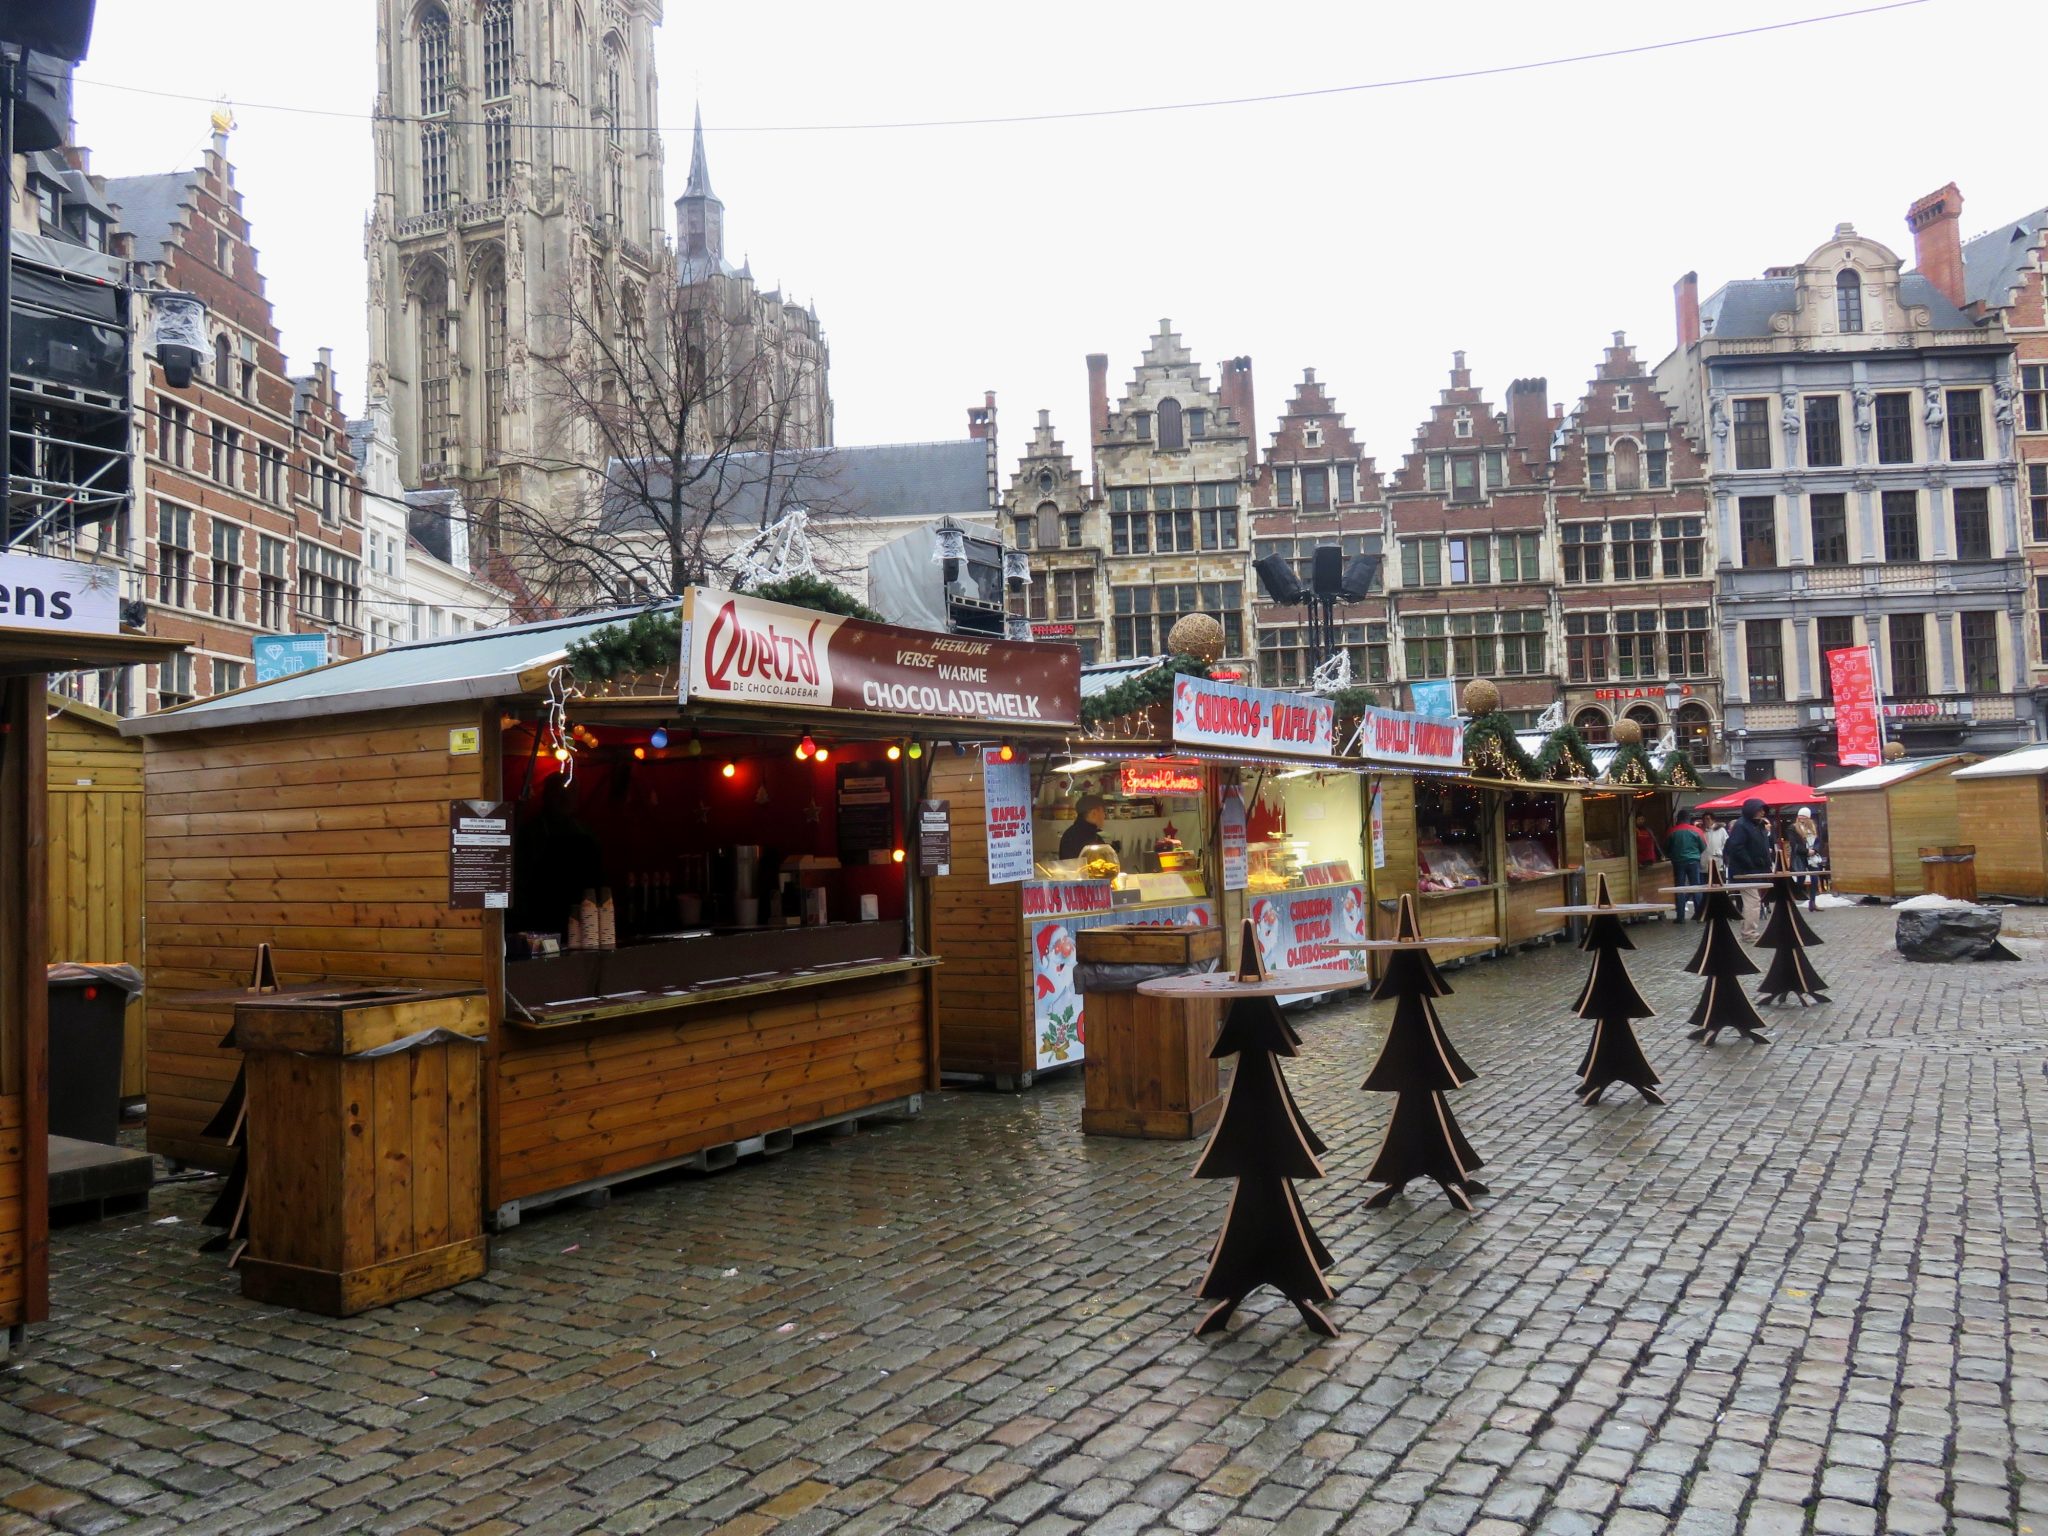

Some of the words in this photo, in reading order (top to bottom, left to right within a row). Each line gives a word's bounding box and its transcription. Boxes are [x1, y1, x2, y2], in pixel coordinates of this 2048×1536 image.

[1031, 624, 1075, 635] PRIMUS
[705, 600, 821, 690] Quetzal
[931, 638, 992, 656] HEERLIJKE
[896, 651, 938, 668] VERSE
[938, 664, 987, 683] WARME
[733, 682, 744, 692] DE
[747, 683, 818, 698] CHOCOLADEBAR
[1595, 687, 1643, 699] BELLA
[863, 681, 1041, 718] CHOCOLADEMELK
[1195, 691, 1261, 738] CHURROS
[1271, 703, 1317, 744] WAFELS
[991, 805, 1026, 822] WAFELS
[1295, 919, 1331, 943] WAFELS
